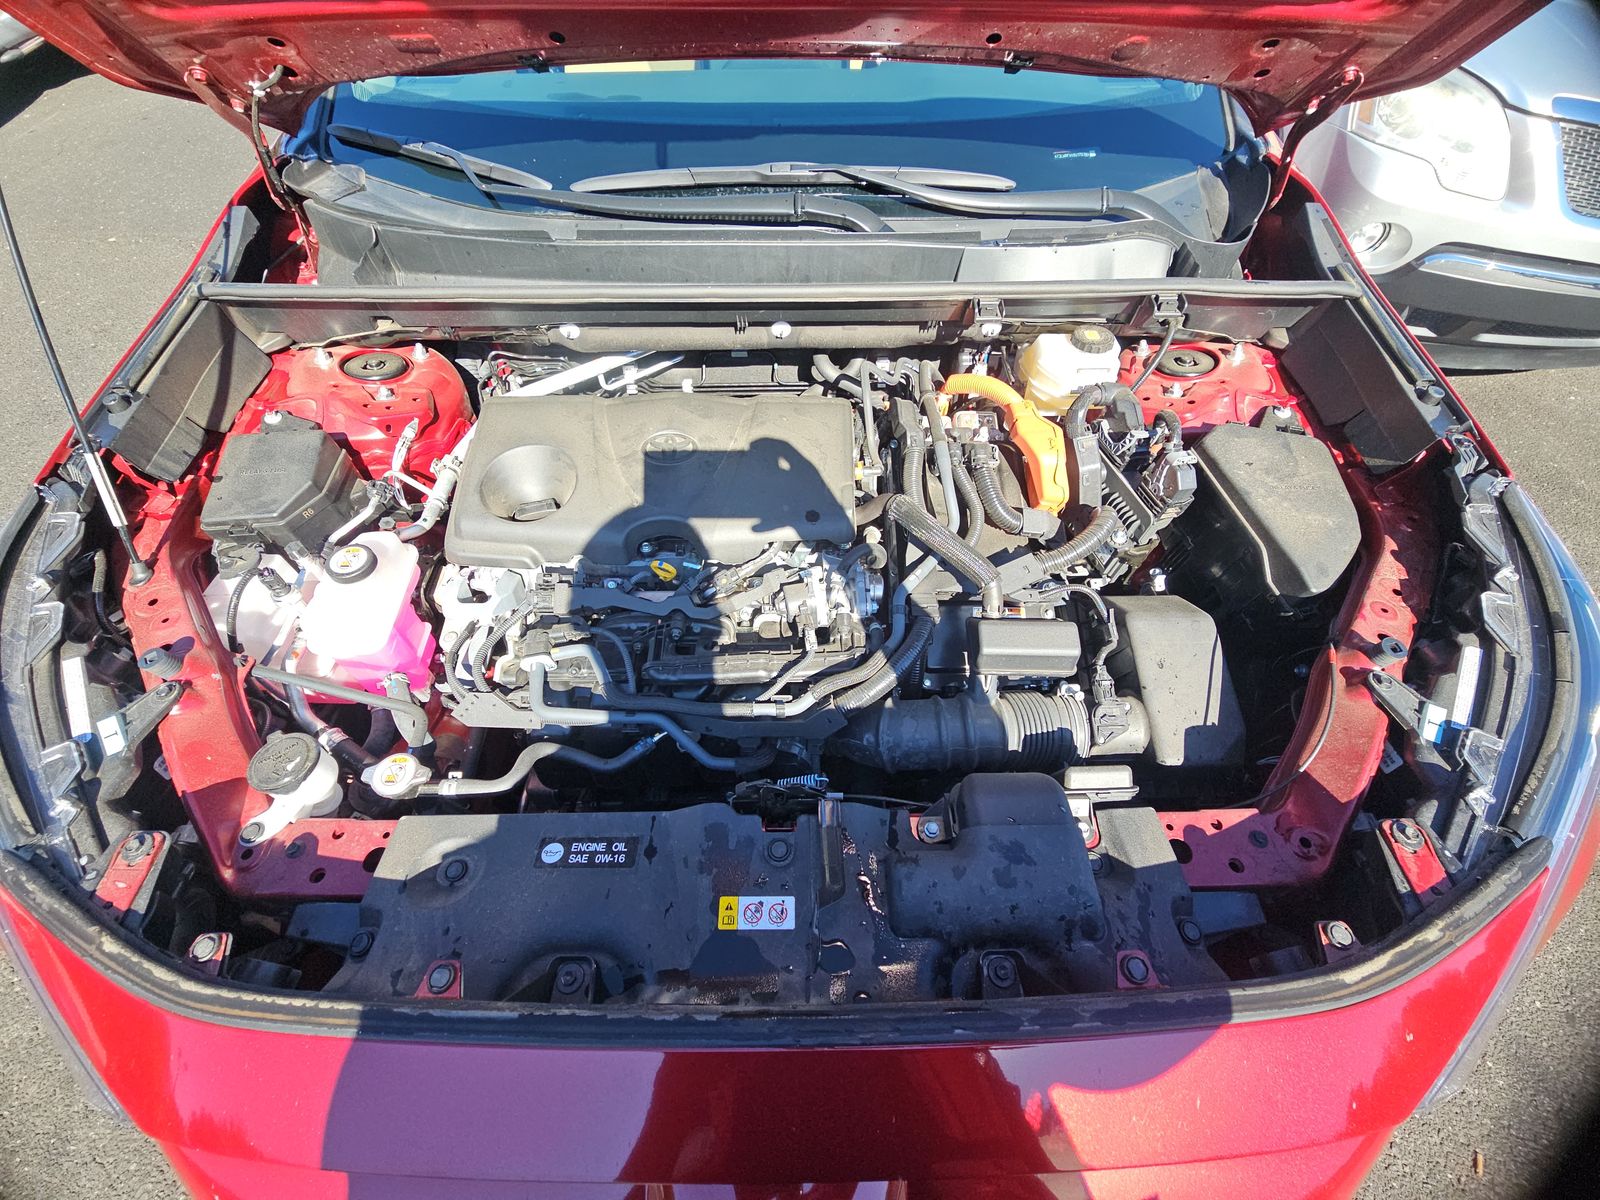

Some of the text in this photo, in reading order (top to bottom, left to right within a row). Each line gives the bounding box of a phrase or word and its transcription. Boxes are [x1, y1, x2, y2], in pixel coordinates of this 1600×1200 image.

[571, 842, 628, 852] ENGINE OIL
[568, 853, 626, 863] SAE 0W-16
